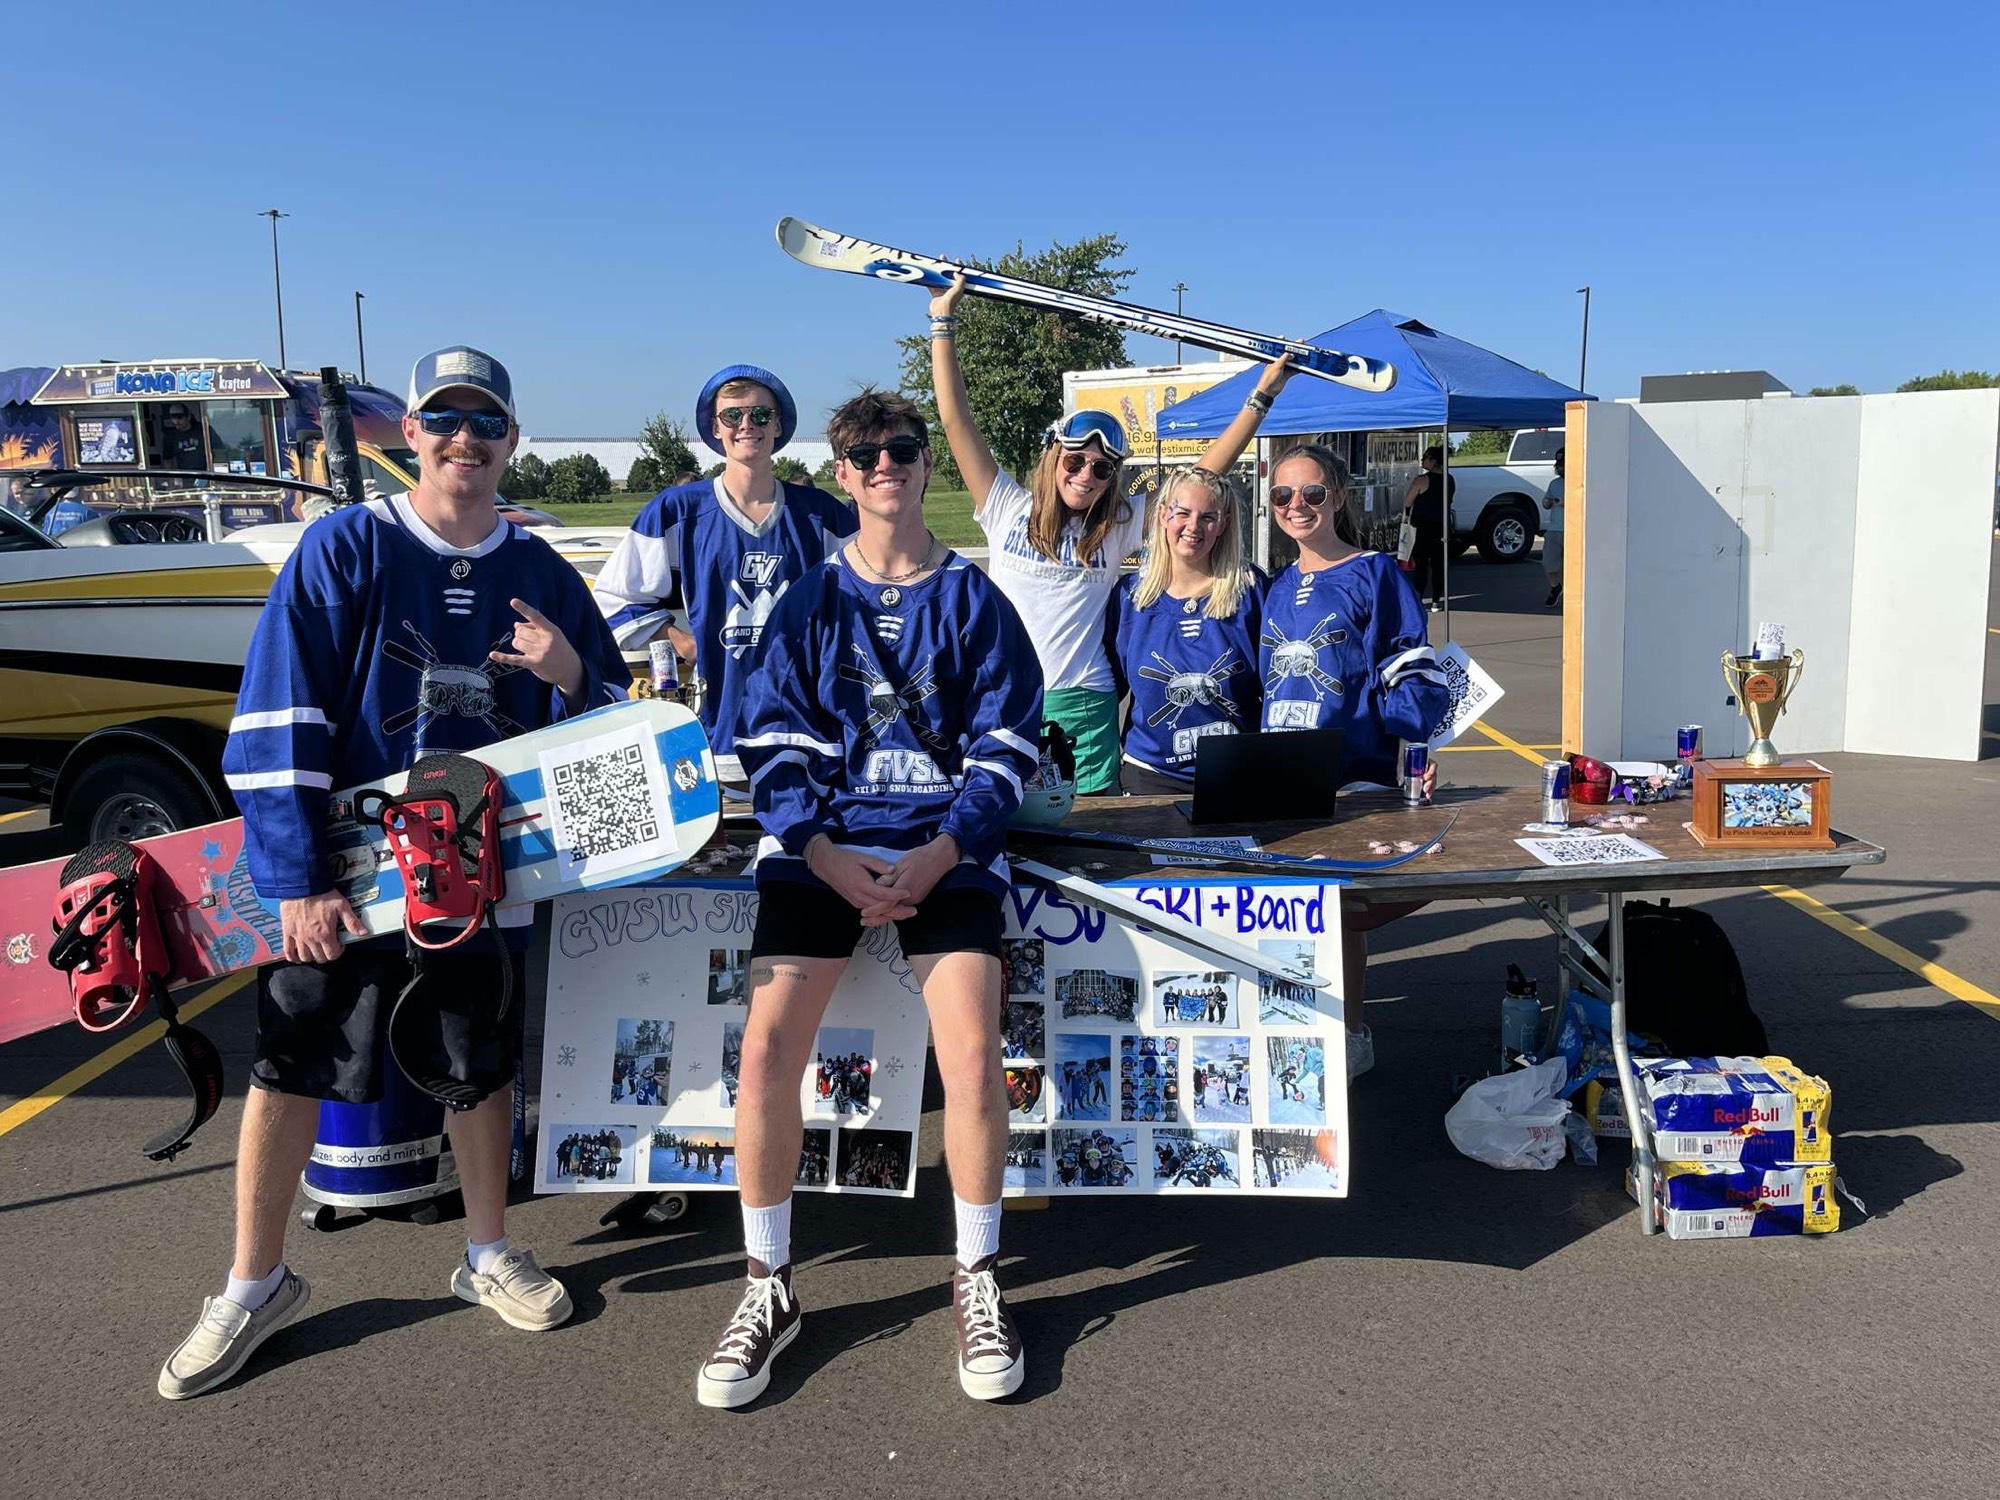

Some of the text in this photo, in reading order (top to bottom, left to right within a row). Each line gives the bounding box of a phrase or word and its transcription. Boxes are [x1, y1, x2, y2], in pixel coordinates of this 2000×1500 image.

[115, 369, 213, 394] KONA ICE
[219, 376, 251, 391] krafted
[1127, 431, 1156, 443] 16.91
[1374, 441, 1403, 462] WAFFLE
[1128, 466, 1159, 496] GOURME
[1369, 529, 1398, 546] 616.916
[739, 551, 783, 587] GV
[1002, 554, 1106, 584] STATE UNIVERSITY
[734, 628, 751, 637] AND
[1166, 756, 1176, 764] SKI
[1178, 754, 1192, 763] AND
[855, 783, 954, 793] SKI AND SNOWBOARDING
[1001, 886, 1106, 945] VSU
[559, 892, 759, 958] GVSU SK
[1713, 1107, 1779, 1123] Red Bull
[1616, 1120, 1630, 1129] Bu
[1717, 1138, 1748, 1146] ENERGY
[337, 1152, 364, 1167] body
[368, 1147, 391, 1164] and
[394, 1144, 429, 1160] mind.
[1726, 1184, 1790, 1200] Red Bull
